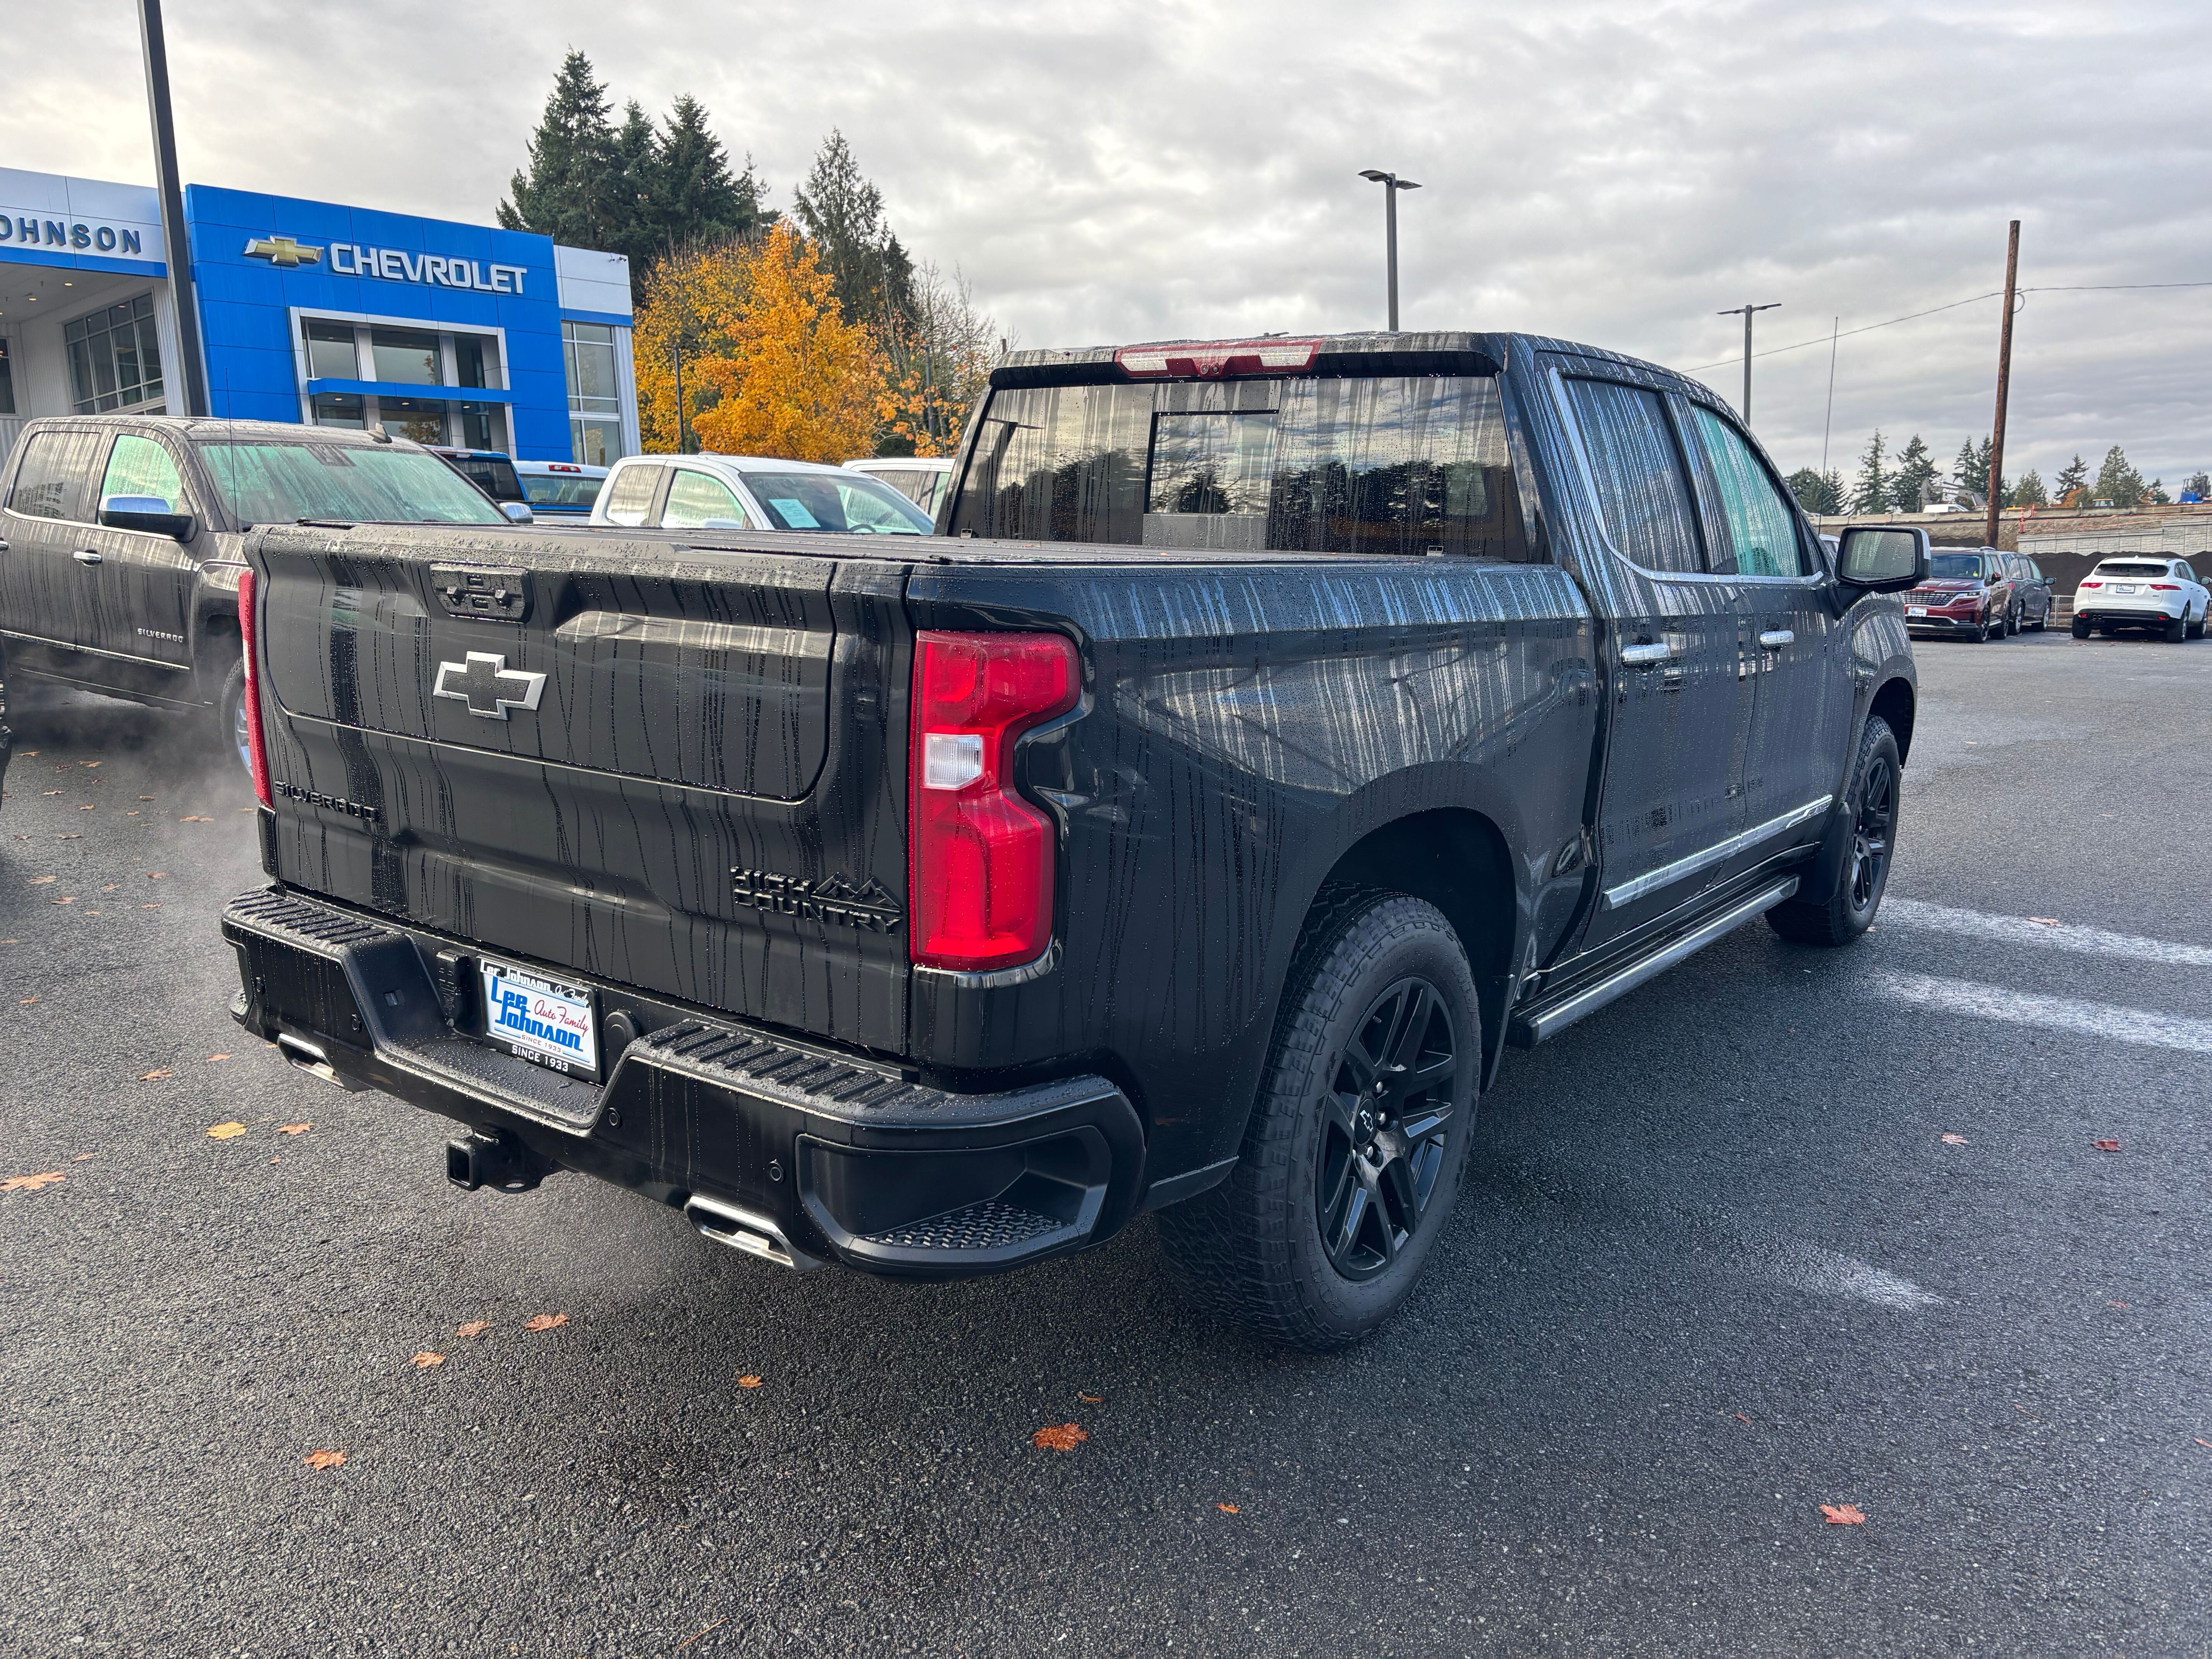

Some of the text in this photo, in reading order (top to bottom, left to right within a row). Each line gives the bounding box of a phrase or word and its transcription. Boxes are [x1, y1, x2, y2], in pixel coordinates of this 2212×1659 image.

[0, 215, 141, 254] OHNSON
[330, 242, 527, 294] CHEVROLET
[137, 628, 184, 643] SILVERADO
[274, 780, 380, 822] SILVERADO
[730, 866, 815, 899] HIGH
[733, 888, 902, 934] COUNTRY
[491, 976, 529, 1010] Lee
[504, 966, 553, 993] Johnson
[495, 1005, 584, 1052] Johnson
[534, 1000, 589, 1038] Auto Family
[512, 1044, 568, 1072] SINCE 1933
[521, 1034, 562, 1053] SINCE 1933
